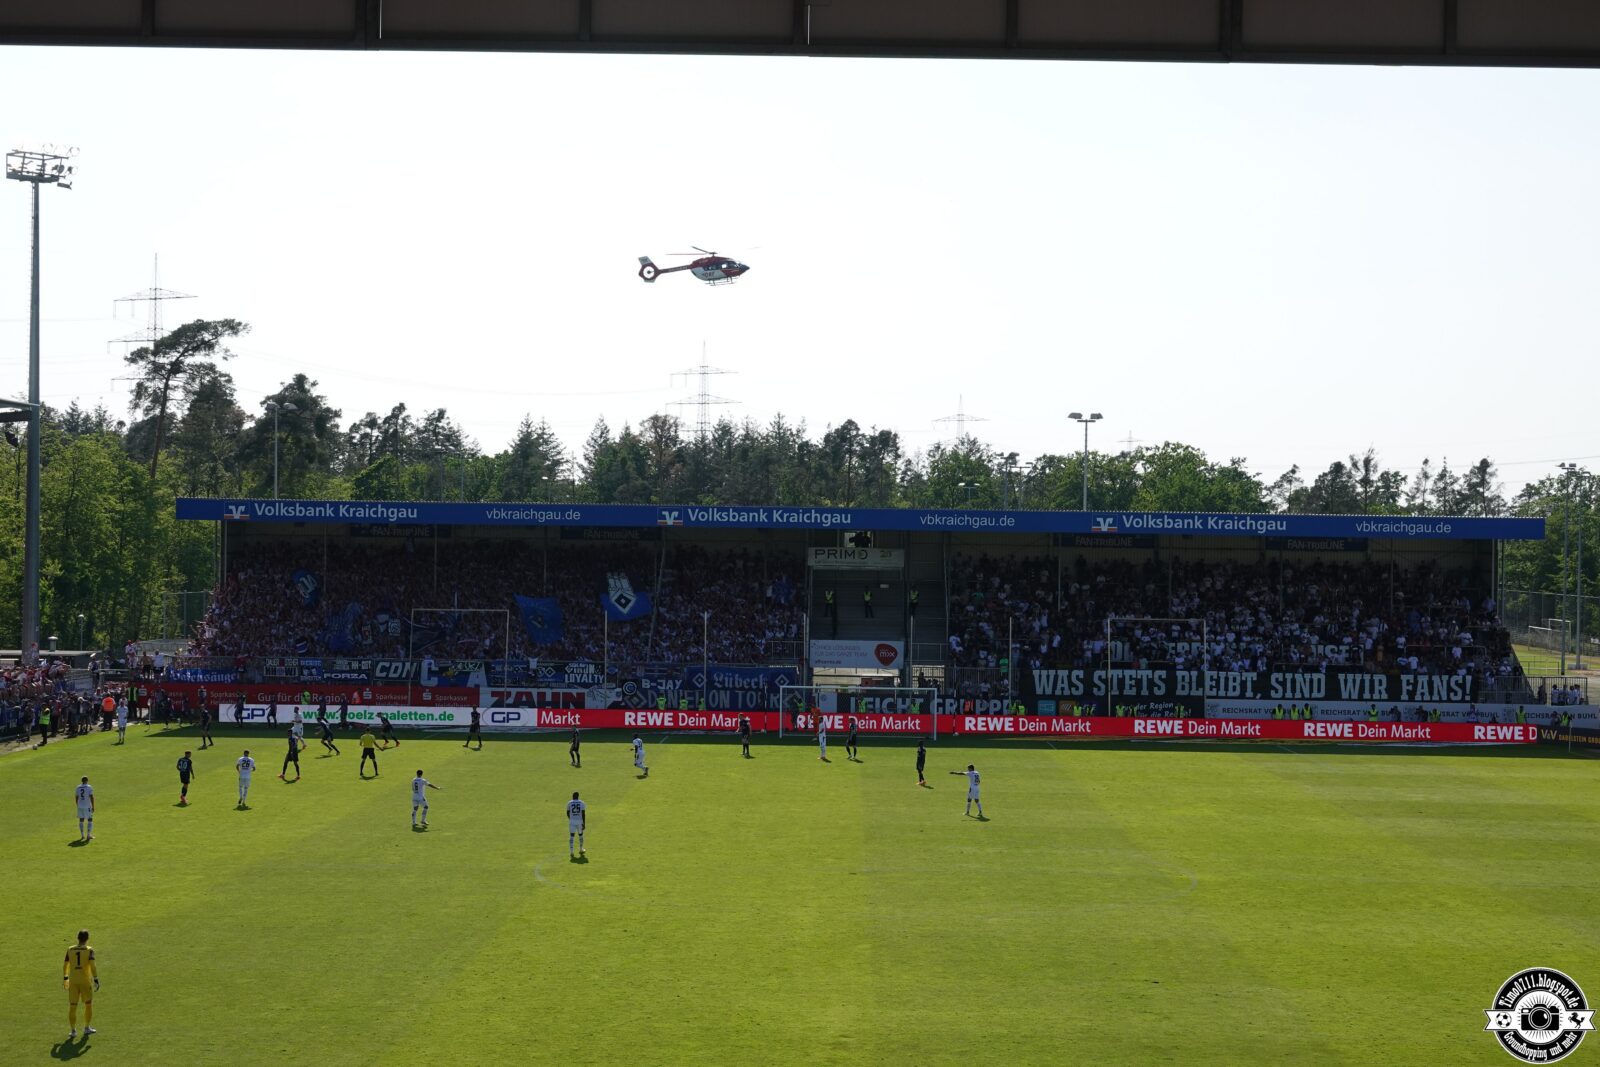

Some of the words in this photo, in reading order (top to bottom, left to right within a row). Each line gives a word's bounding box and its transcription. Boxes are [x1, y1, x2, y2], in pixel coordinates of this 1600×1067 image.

[254, 503, 335, 518] Volksbank
[339, 504, 418, 521] Kraichgau
[486, 508, 581, 522] vbkraichgau.de
[688, 508, 769, 523] Volksbank
[773, 509, 852, 527] Kraichgau
[919, 514, 1016, 528] vbkraichgau.de
[1122, 514, 1204, 529] Volksbank
[1207, 516, 1287, 533] Kraichgau
[1356, 521, 1452, 535] vbkraichgau.de
[814, 549, 868, 560] PRIMO
[1032, 669, 1084, 696] WAS
[1092, 669, 1167, 696] STETS
[1269, 672, 1326, 699] SIND
[1337, 673, 1388, 700] WIR
[1399, 674, 1472, 702] FANS!
[435, 694, 468, 702] Sparkasse
[491, 711, 521, 724] GP
[541, 712, 582, 725] Markt
[624, 712, 674, 726] REWE
[678, 713, 709, 727] Dein
[881, 715, 921, 730] Markt
[964, 716, 1014, 731] REWE
[1018, 717, 1047, 732] Dein
[1051, 718, 1091, 733] Markt
[1133, 719, 1184, 734] REWE
[1187, 721, 1217, 735] Dein
[1220, 722, 1261, 736] Markt
[1303, 722, 1353, 737] REWE
[1357, 723, 1387, 738] Dein
[1390, 724, 1431, 739] Markt
[1474, 725, 1524, 740] REWE
